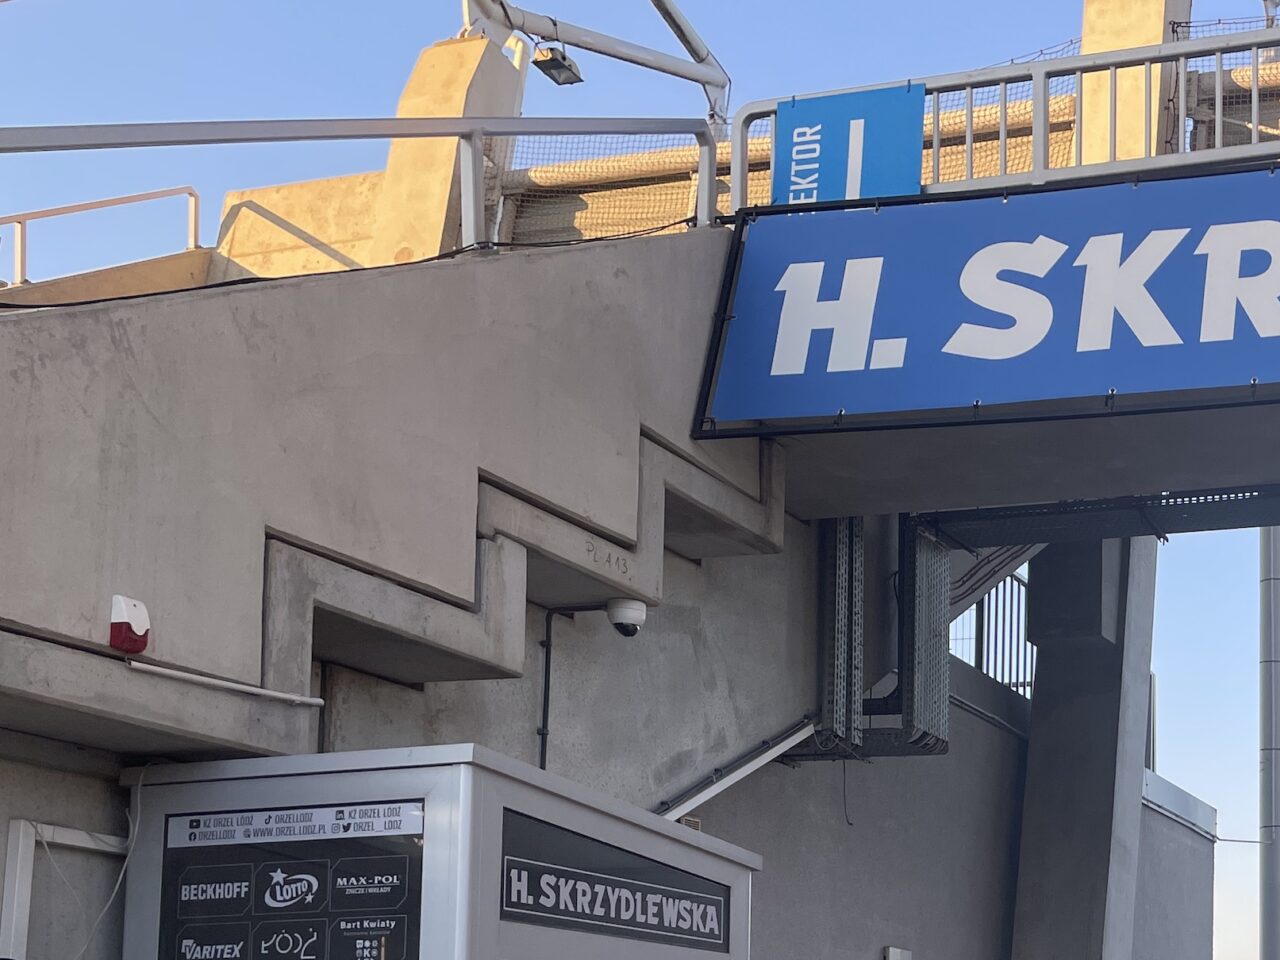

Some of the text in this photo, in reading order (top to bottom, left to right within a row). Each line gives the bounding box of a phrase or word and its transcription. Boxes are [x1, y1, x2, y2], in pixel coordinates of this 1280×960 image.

[788, 124, 822, 214] EKTOR
[771, 257, 907, 376] H.
[275, 879, 308, 902] LOTTO
[336, 875, 400, 886] MAX-POL
[181, 882, 249, 901] BECKHOFF
[510, 868, 720, 935] H. SKRZYDLEWSKA
[340, 919, 396, 930] Bart Kwiaty
[183, 940, 244, 960] VARITEX
